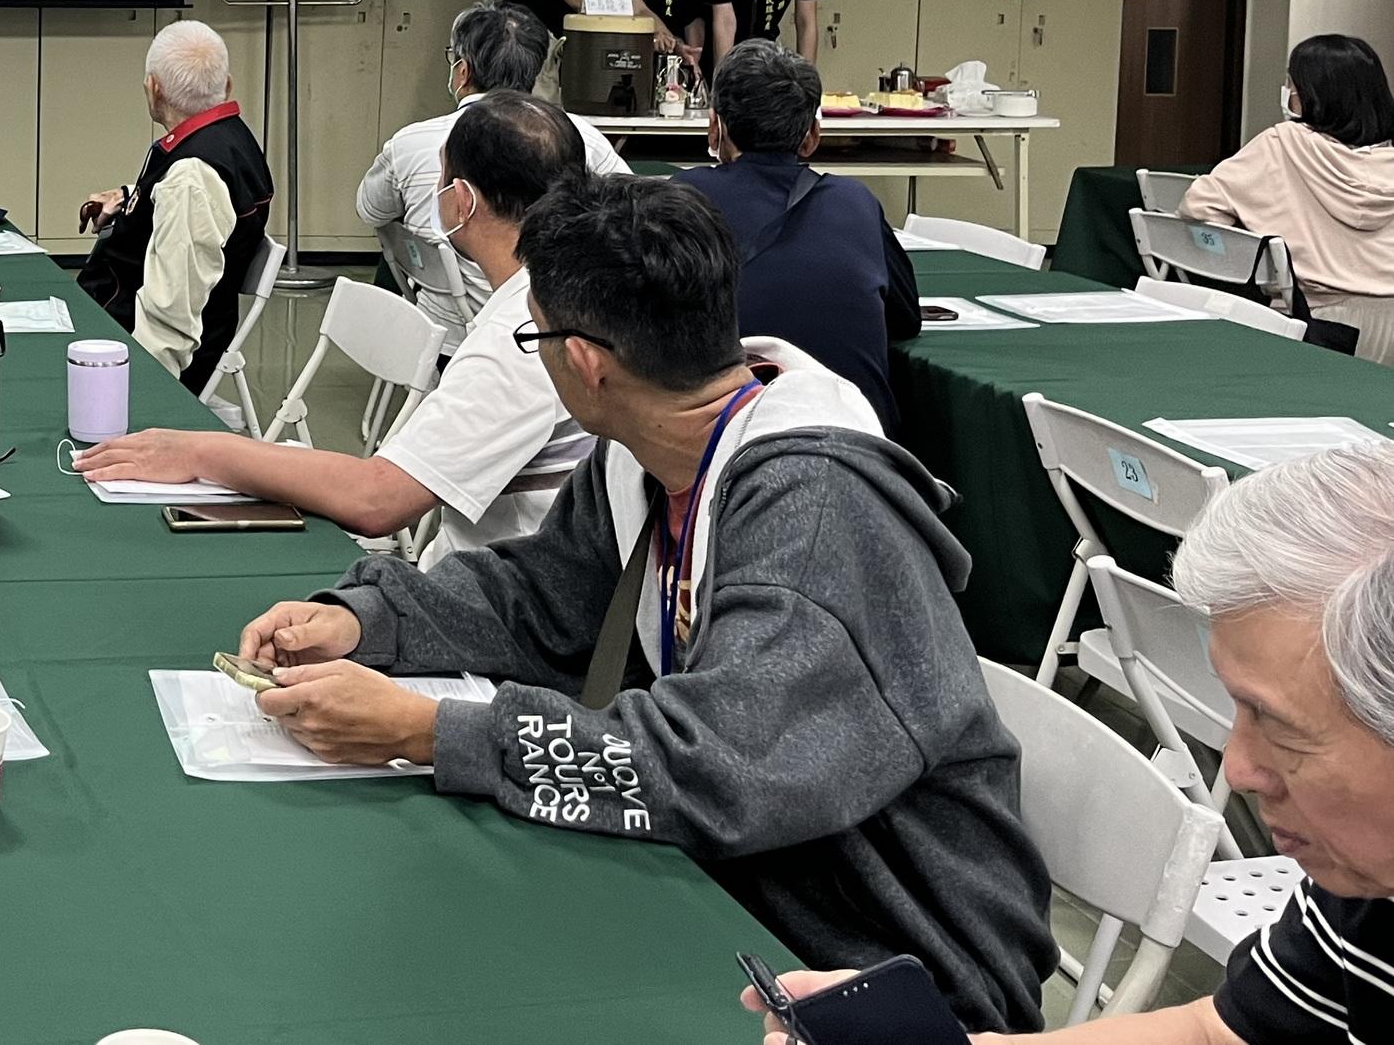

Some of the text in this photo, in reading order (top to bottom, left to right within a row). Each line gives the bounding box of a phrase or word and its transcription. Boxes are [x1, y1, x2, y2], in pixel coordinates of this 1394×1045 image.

[1121, 460, 1139, 483] 23
[517, 714, 561, 823] RANCE
[546, 714, 591, 822] TOURS
